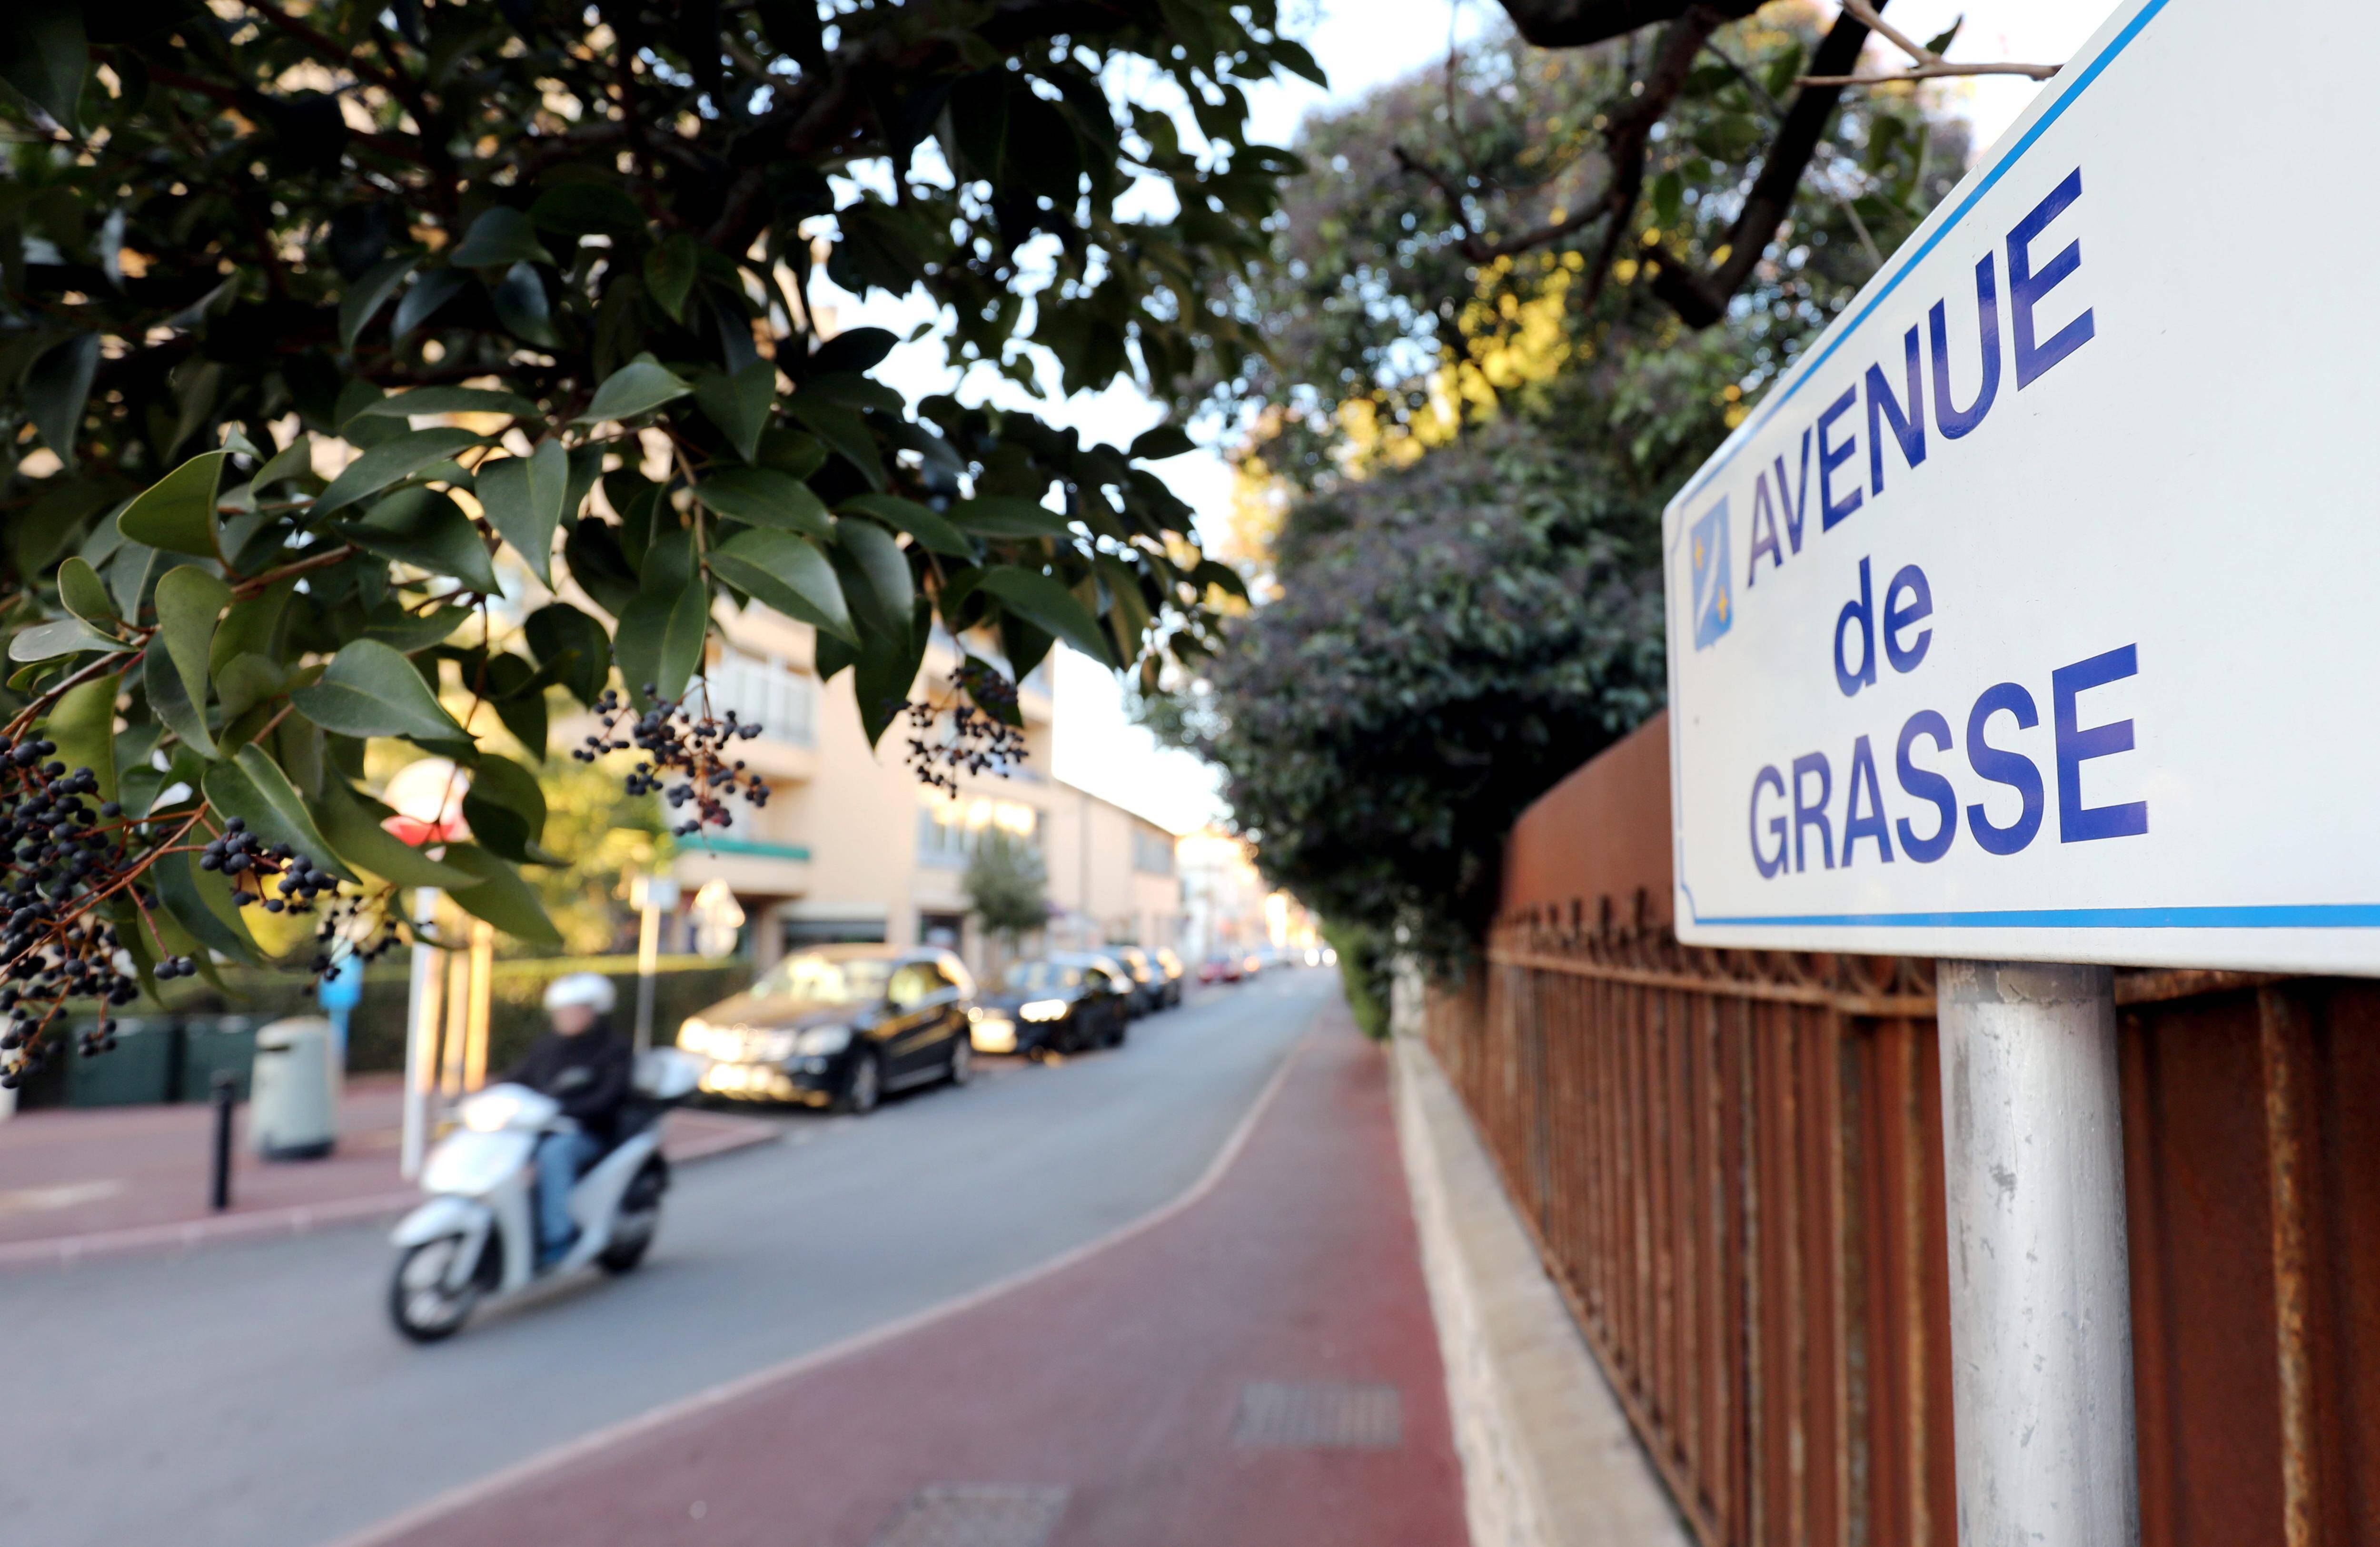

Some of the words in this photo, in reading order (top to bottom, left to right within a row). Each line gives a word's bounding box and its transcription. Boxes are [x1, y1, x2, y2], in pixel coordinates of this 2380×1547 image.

[1747, 167, 2095, 588] AVENUE
[1834, 555, 1933, 697] de
[1750, 643, 2148, 879] GRASSE
